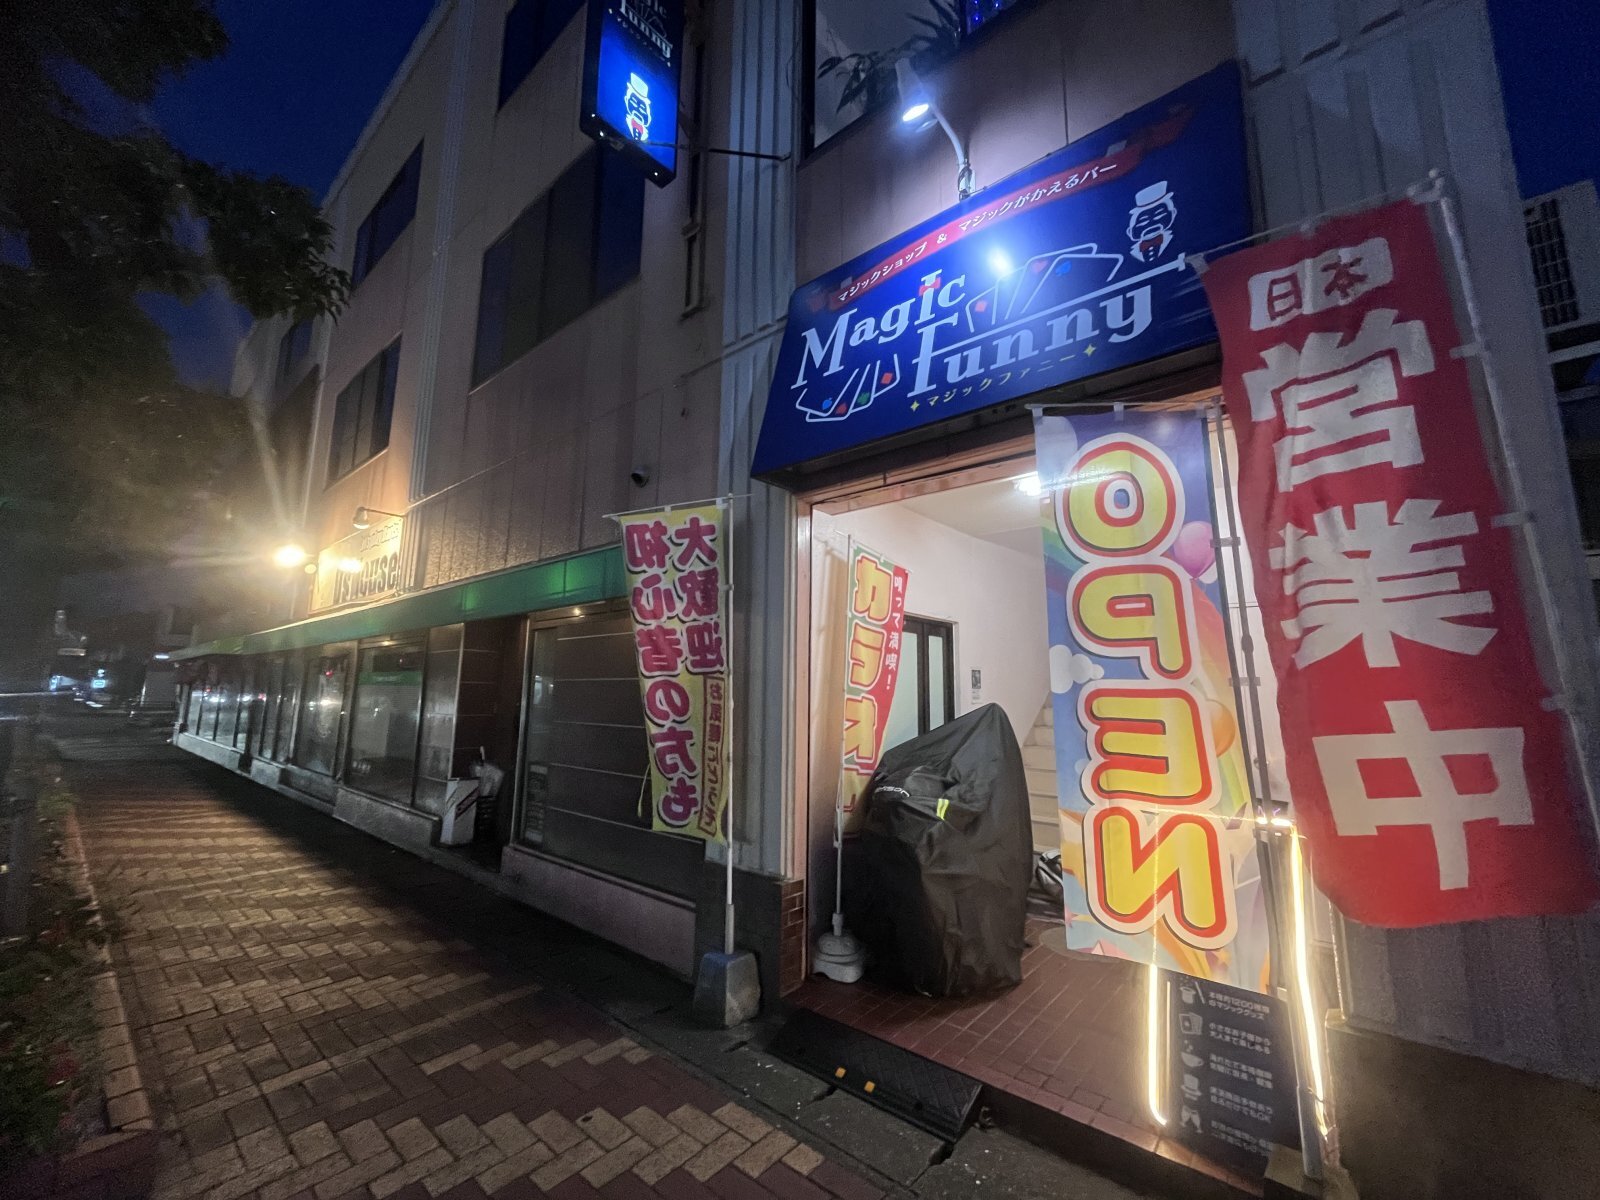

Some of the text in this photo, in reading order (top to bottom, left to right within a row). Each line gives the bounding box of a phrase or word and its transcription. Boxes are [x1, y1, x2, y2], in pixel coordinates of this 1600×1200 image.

[838, 164, 1118, 301] マジックショップ & マジックがかえるバー
[907, 280, 1155, 398] Funny
[928, 354, 1077, 406] マジックファニー
